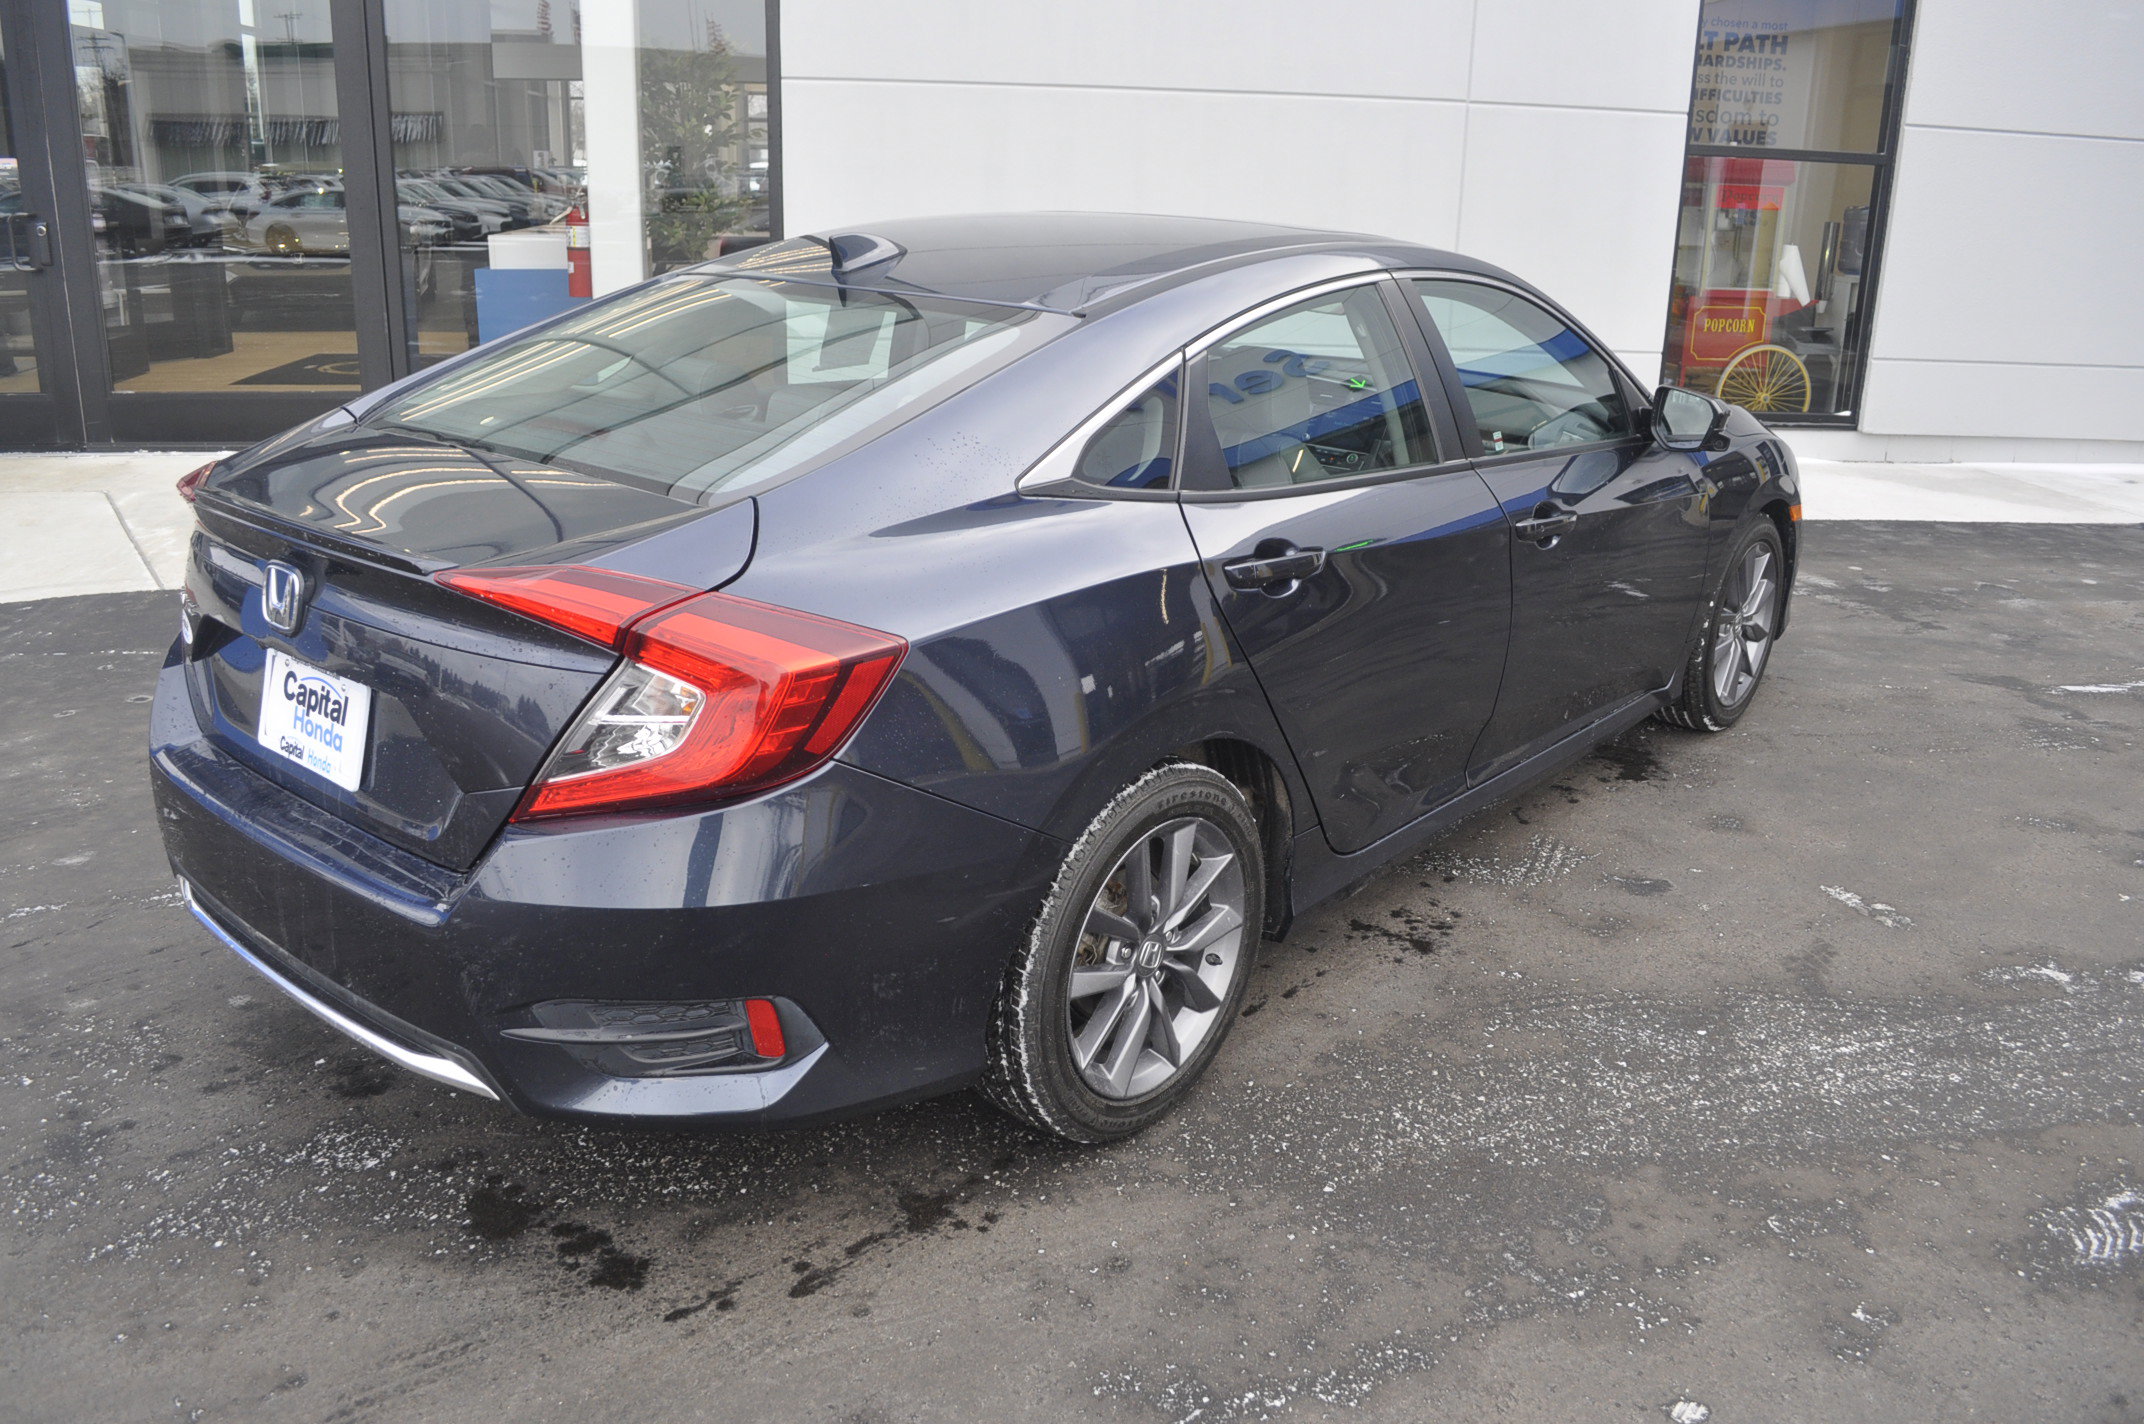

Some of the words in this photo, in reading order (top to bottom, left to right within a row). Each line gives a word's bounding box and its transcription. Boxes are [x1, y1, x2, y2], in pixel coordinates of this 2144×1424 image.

[1711, 16, 1749, 29] chosen
[1752, 21, 1759, 30] a
[1761, 21, 1789, 31] most
[1699, 31, 1719, 50] T
[1724, 32, 1789, 55] PATH
[1714, 71, 1738, 85] the
[1742, 73, 1766, 88] will
[1770, 76, 1785, 88] to
[1759, 109, 1780, 127] to
[1707, 128, 1778, 146] VALUES
[1704, 318, 1756, 334] POPCORN
[284, 671, 349, 727] Capital
[293, 706, 343, 753] Honda
[280, 736, 305, 760] Capital
[307, 750, 332, 775] Honda
